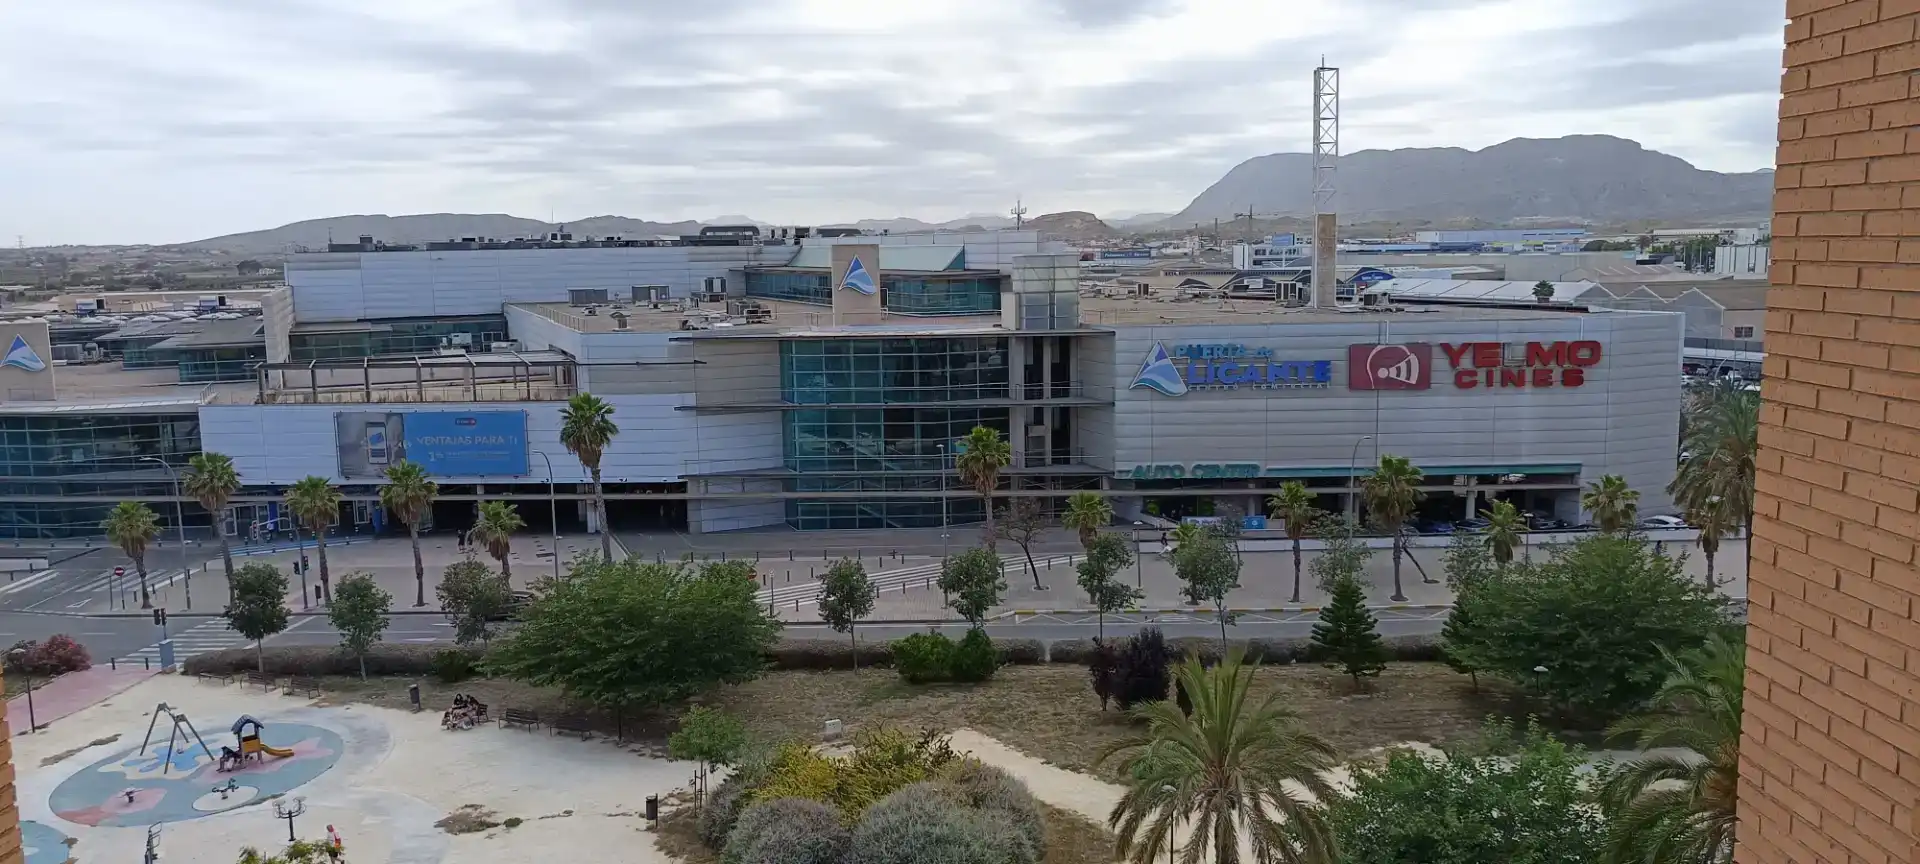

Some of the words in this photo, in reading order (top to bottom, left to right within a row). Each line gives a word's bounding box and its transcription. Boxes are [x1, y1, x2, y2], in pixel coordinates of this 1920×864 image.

[1176, 344, 1246, 358] PUERTA
[1454, 368, 1585, 389] CINES
[417, 435, 472, 446] VENTAJAS
[474, 434, 504, 445] PARA
[508, 435, 518, 444] TI
[1132, 465, 1185, 478] AUTO
[1191, 464, 1260, 478] CENTER
